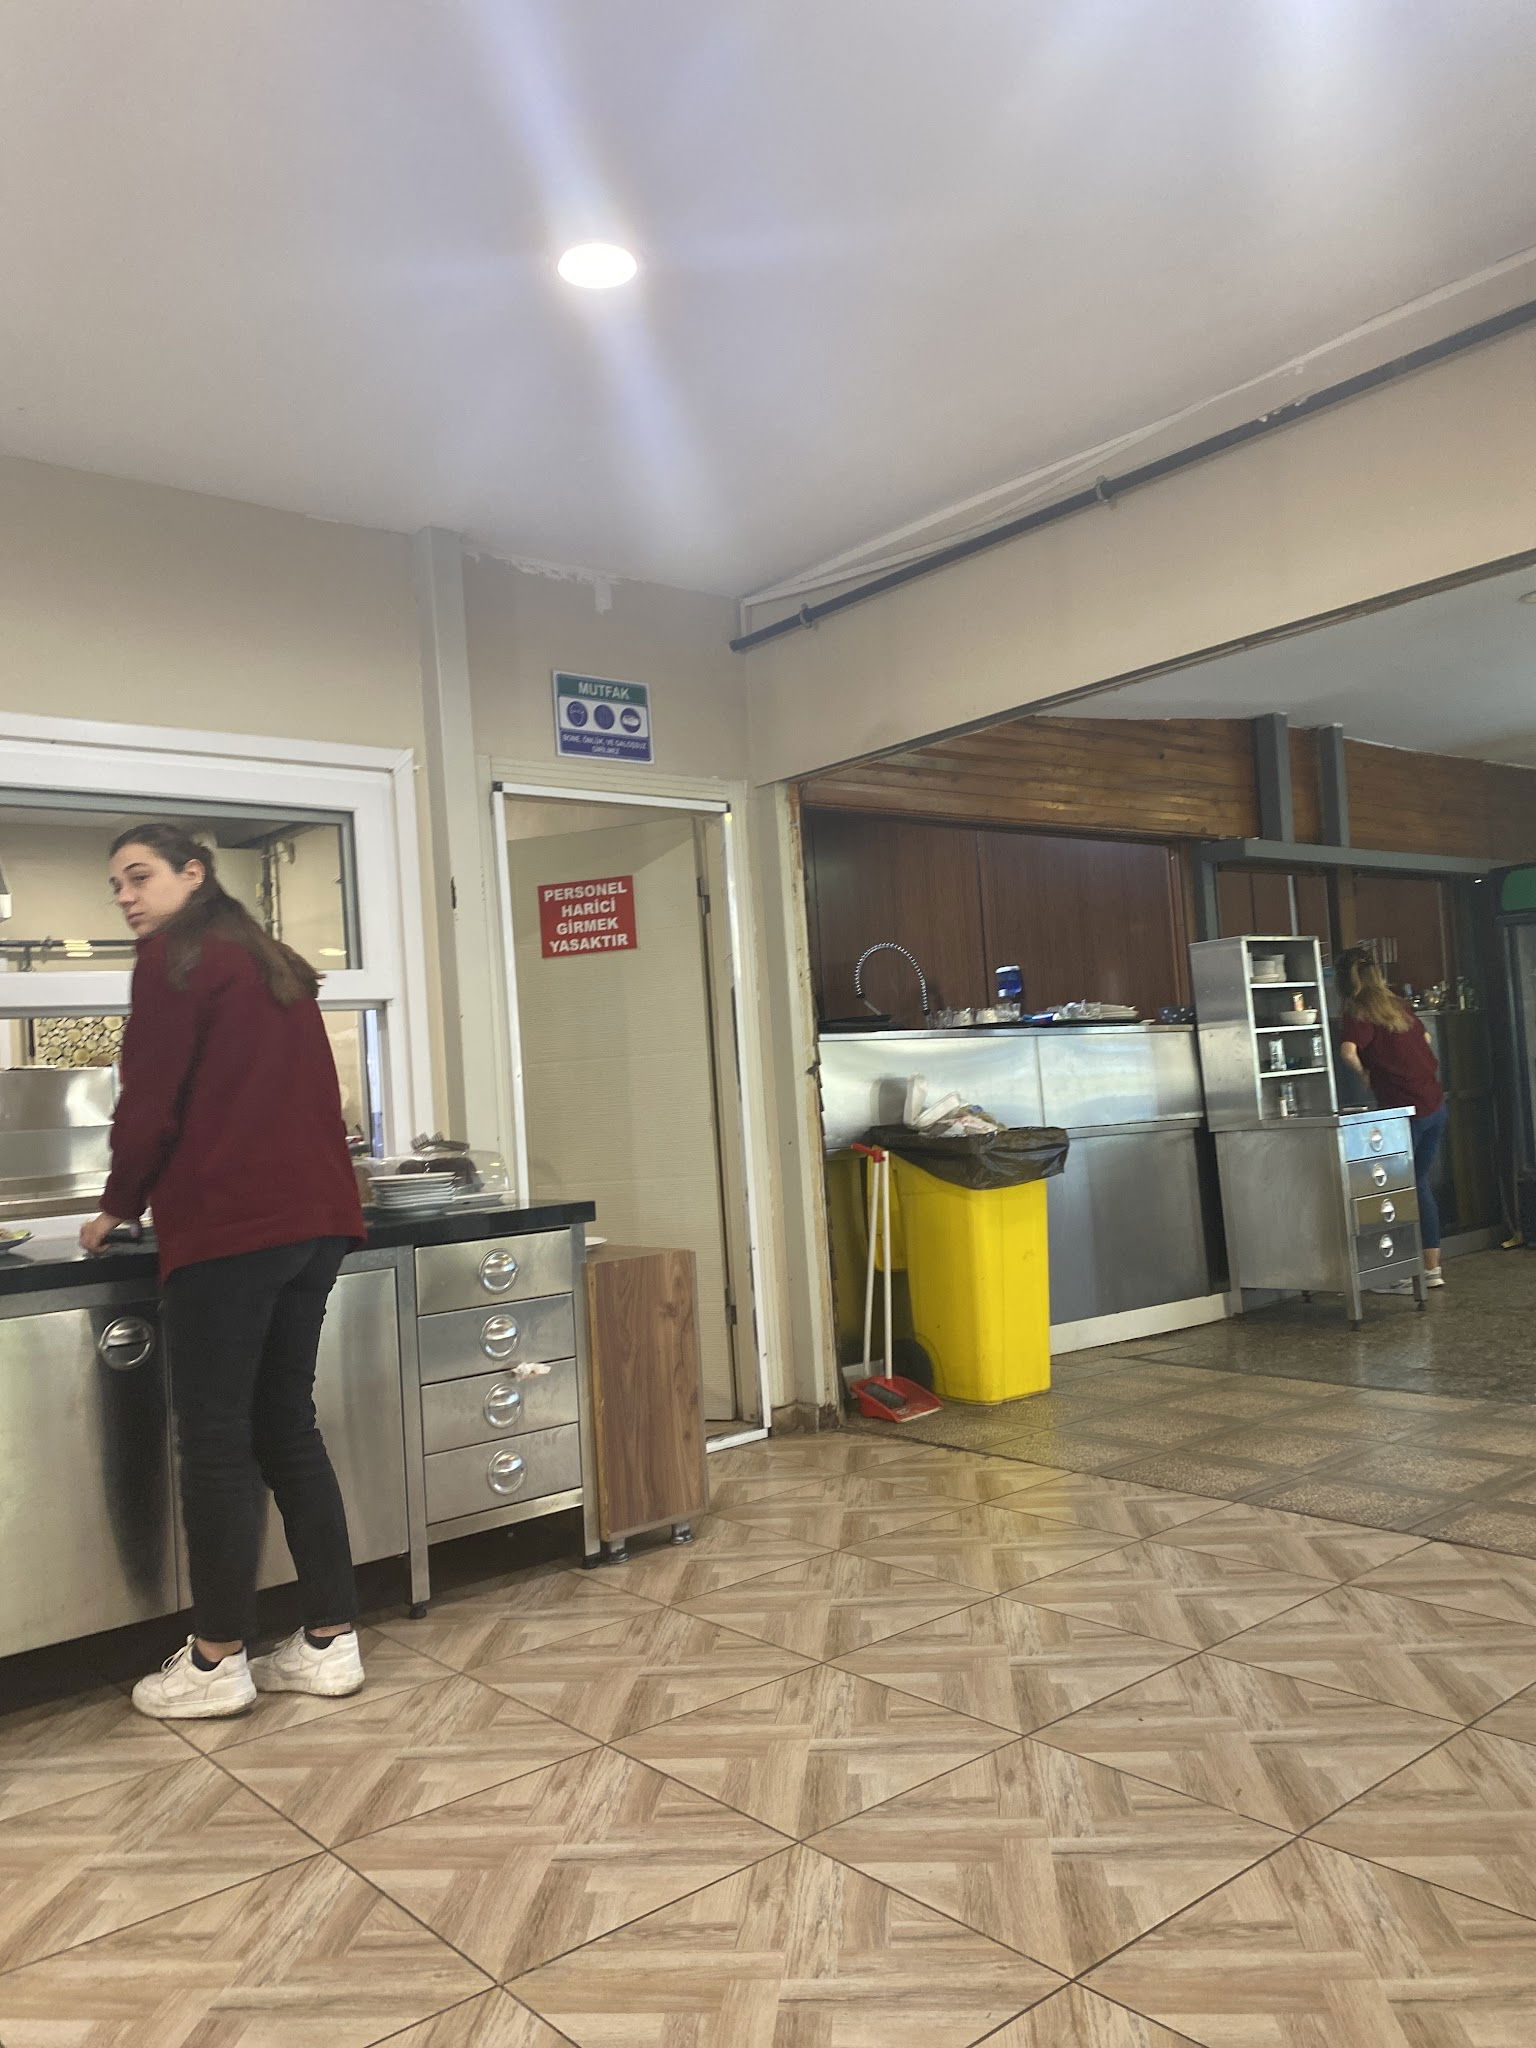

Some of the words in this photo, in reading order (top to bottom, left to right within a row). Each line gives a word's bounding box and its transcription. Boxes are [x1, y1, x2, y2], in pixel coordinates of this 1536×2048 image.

[578, 682, 630, 700] MUTFAK
[544, 881, 628, 902] PERSONEL
[561, 896, 616, 917] HARİCİ
[556, 916, 619, 936] GİRMEK
[549, 933, 629, 953] YASAKTIR
